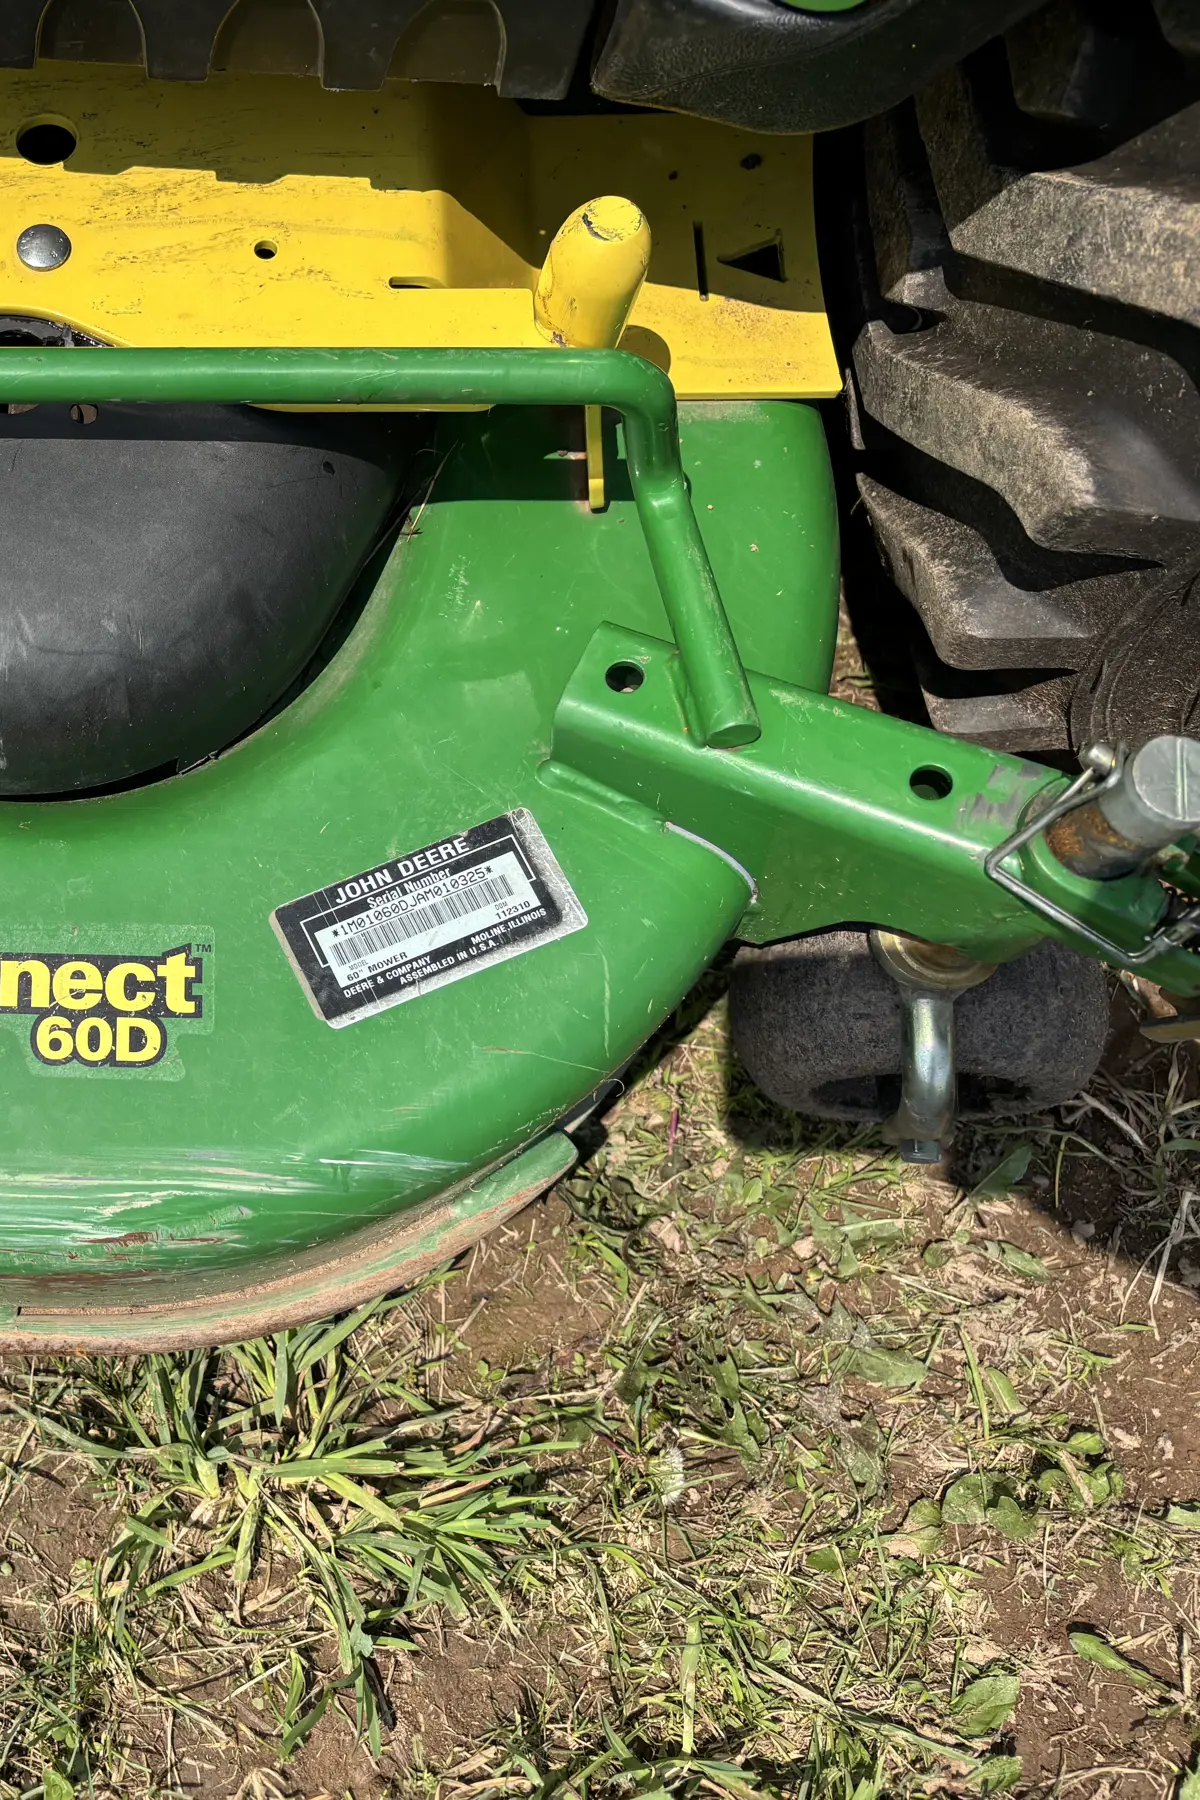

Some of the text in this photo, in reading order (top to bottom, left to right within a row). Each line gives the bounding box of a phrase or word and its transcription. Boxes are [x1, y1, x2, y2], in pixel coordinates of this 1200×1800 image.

[335, 837, 470, 904] JOHN DEERE
[366, 867, 451, 909] Serial Number
[495, 900, 531, 920] 112310
[343, 955, 431, 998] DEERE & COMPANY
[348, 959, 369, 971] MODEL
[367, 951, 408, 973] MOWER
[400, 956, 455, 985] ASSEMBLED
[455, 949, 469, 961] IN
[36, 1016, 162, 1062] 60D
